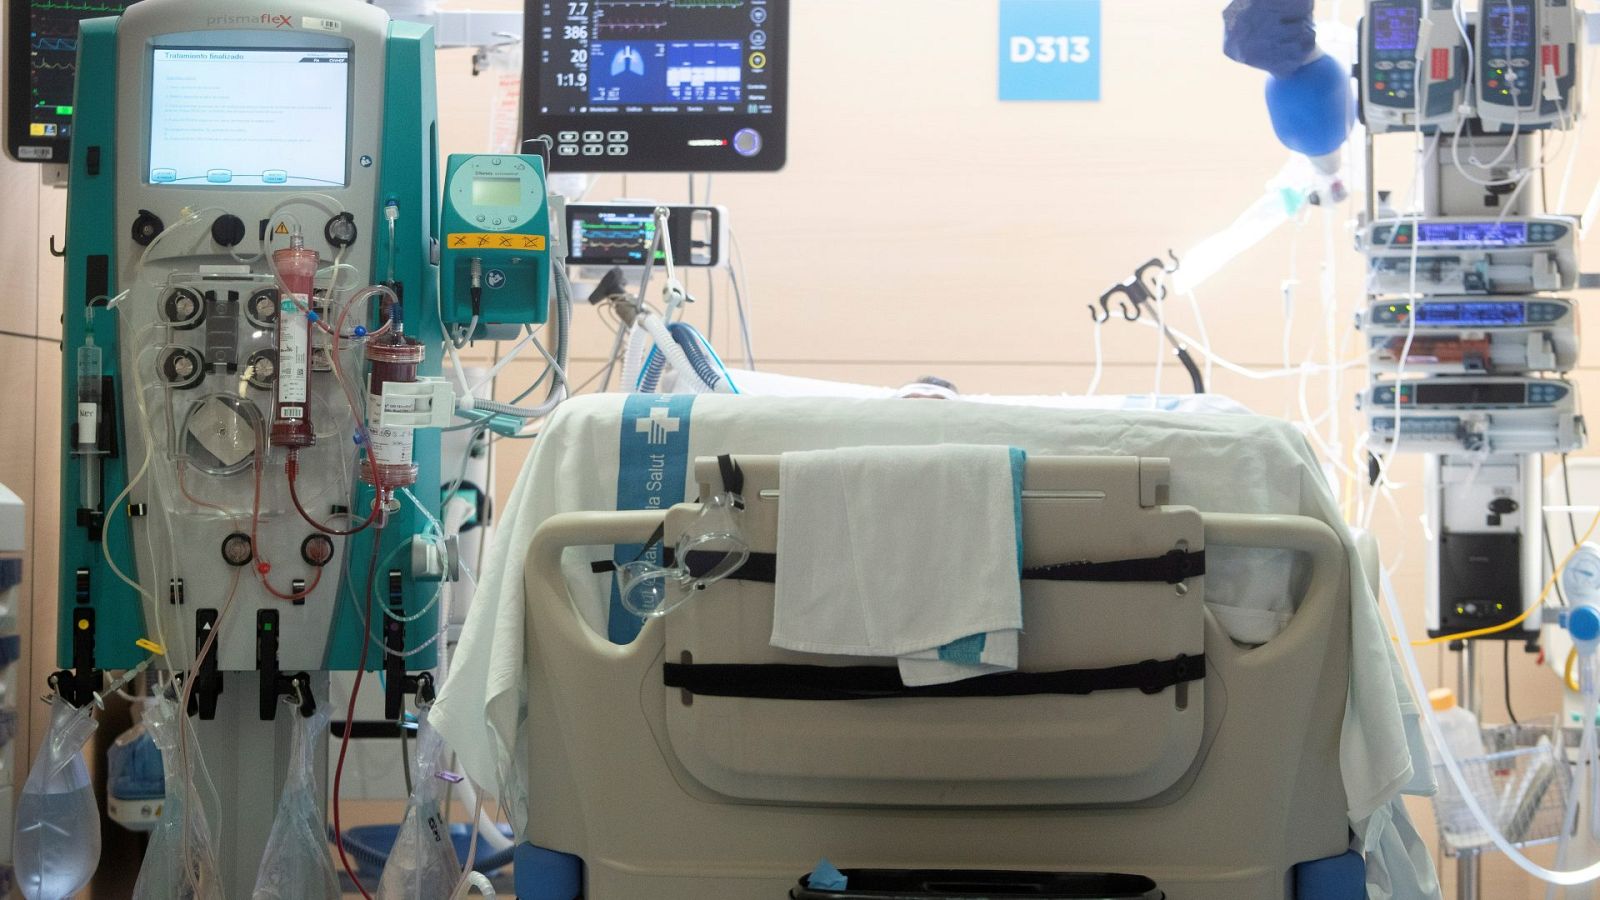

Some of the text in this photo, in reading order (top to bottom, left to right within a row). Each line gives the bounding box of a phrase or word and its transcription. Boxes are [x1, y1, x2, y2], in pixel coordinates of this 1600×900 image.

[568, 2, 588, 16] 7.7
[563, 25, 588, 39] 386
[164, 52, 208, 60] Tratamiento
[570, 49, 588, 63] 20
[1010, 37, 1090, 63] D313
[556, 73, 587, 87] 1:1.9
[646, 453, 665, 491] Salut
